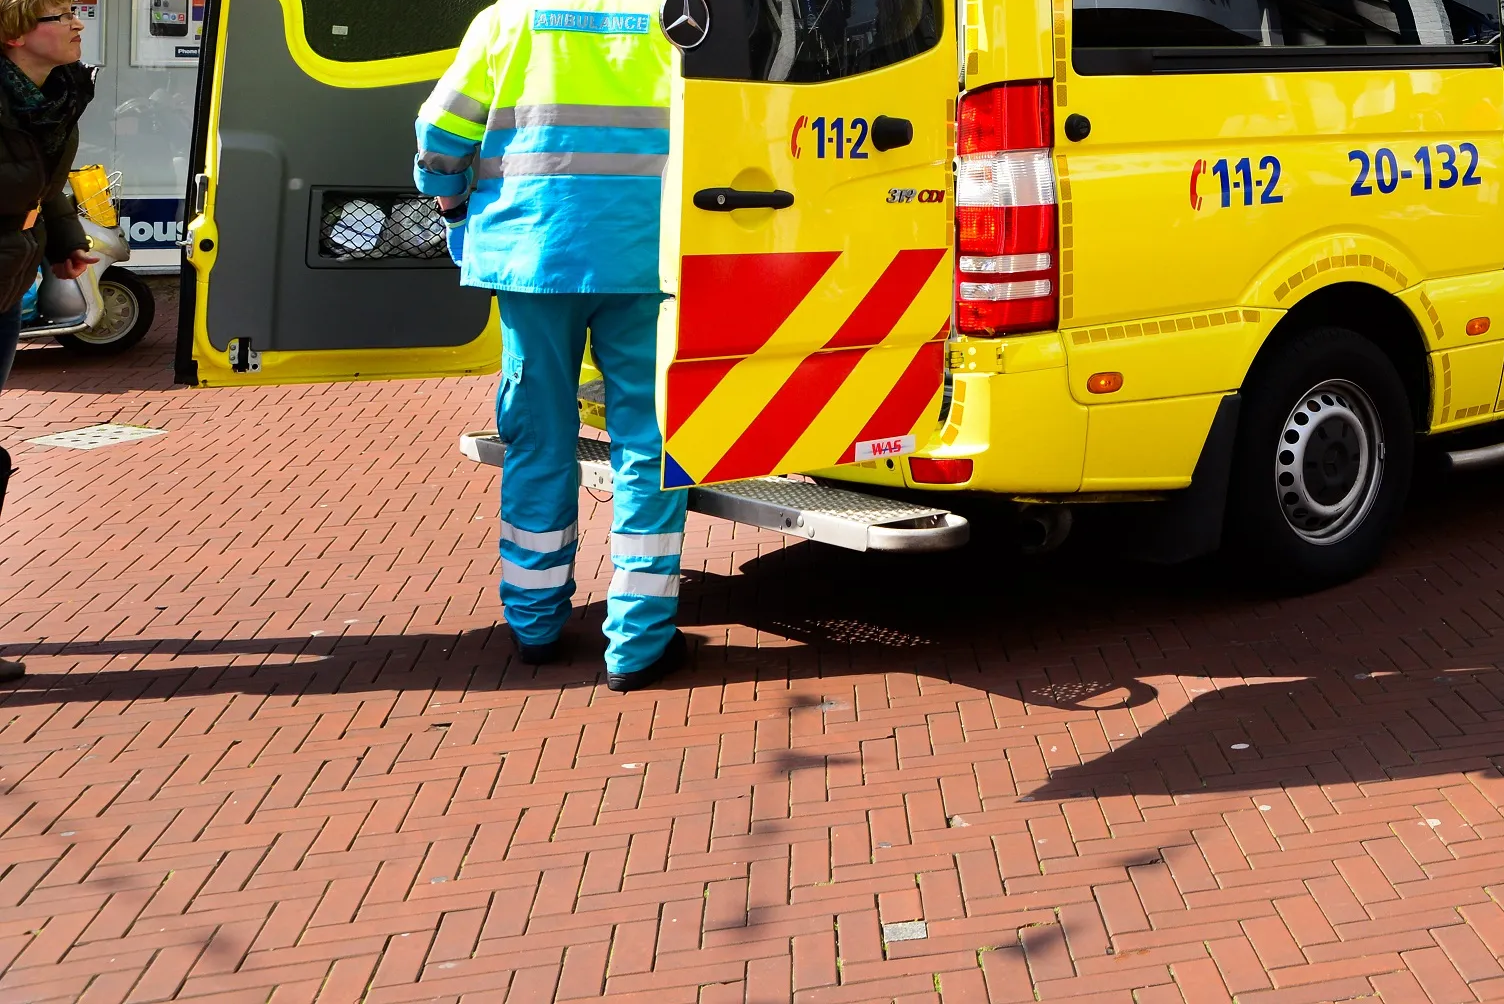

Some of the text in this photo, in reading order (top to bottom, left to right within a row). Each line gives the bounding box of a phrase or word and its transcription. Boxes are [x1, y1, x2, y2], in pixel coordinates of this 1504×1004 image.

[536, 13, 648, 30] AMBULANCE
[1348, 142, 1482, 196] 20-132
[886, 188, 945, 203] 319 CDI
[871, 440, 902, 455] WAS
